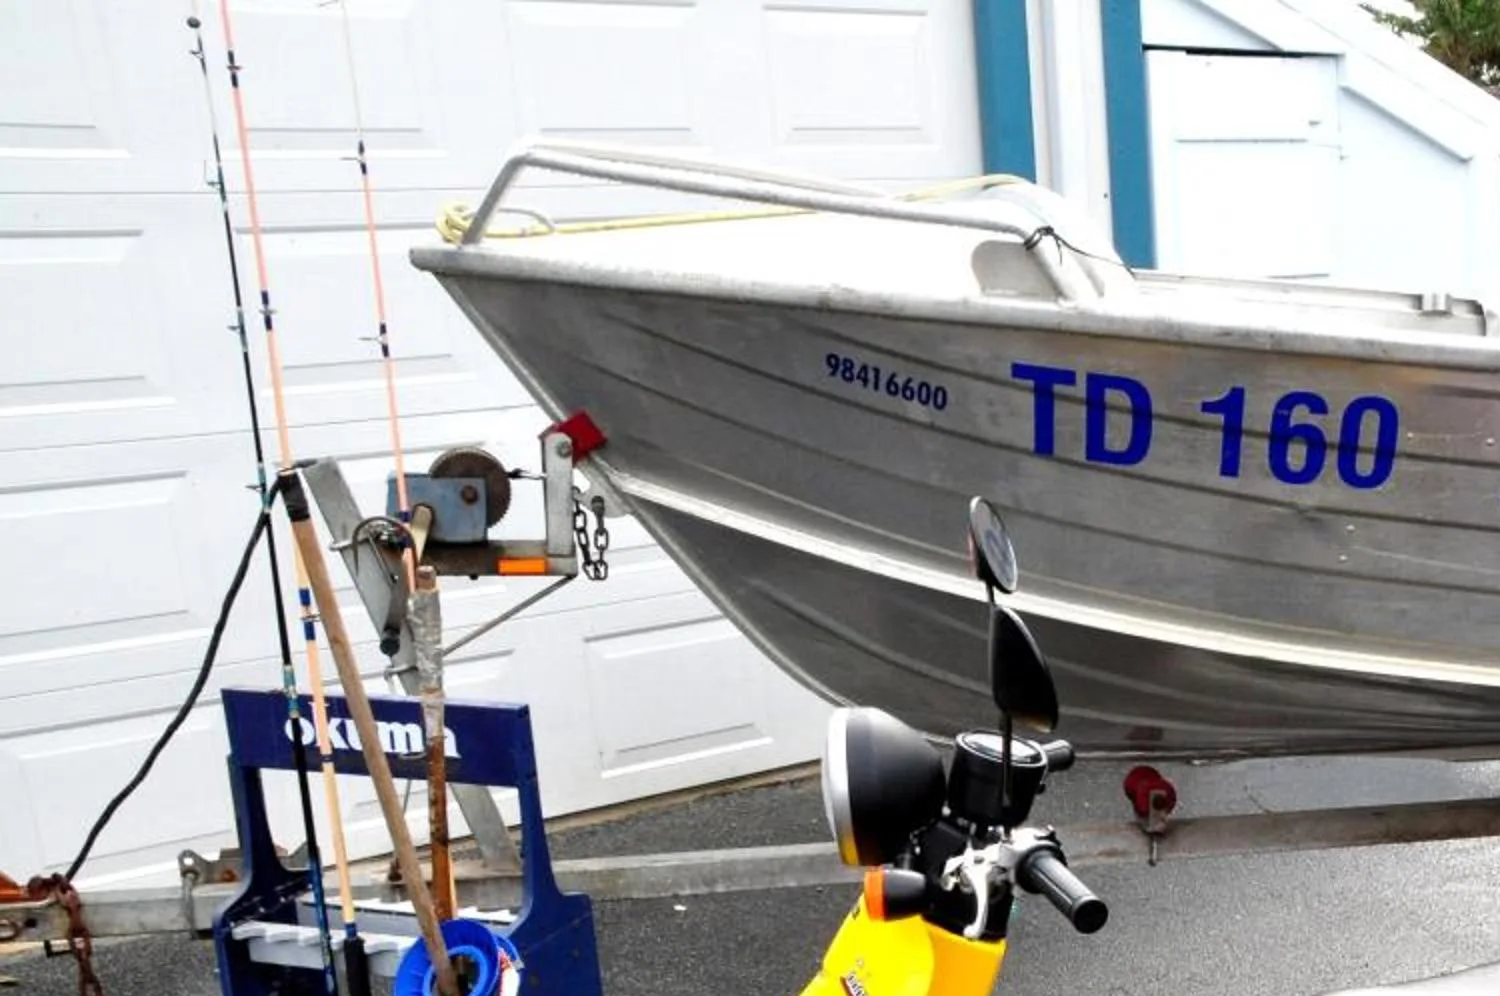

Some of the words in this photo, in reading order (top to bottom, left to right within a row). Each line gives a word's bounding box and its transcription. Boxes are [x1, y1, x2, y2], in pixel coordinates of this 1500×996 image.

[826, 353, 948, 411] 98416600
[1011, 362, 1152, 466] TD
[1201, 386, 1400, 489] 160
